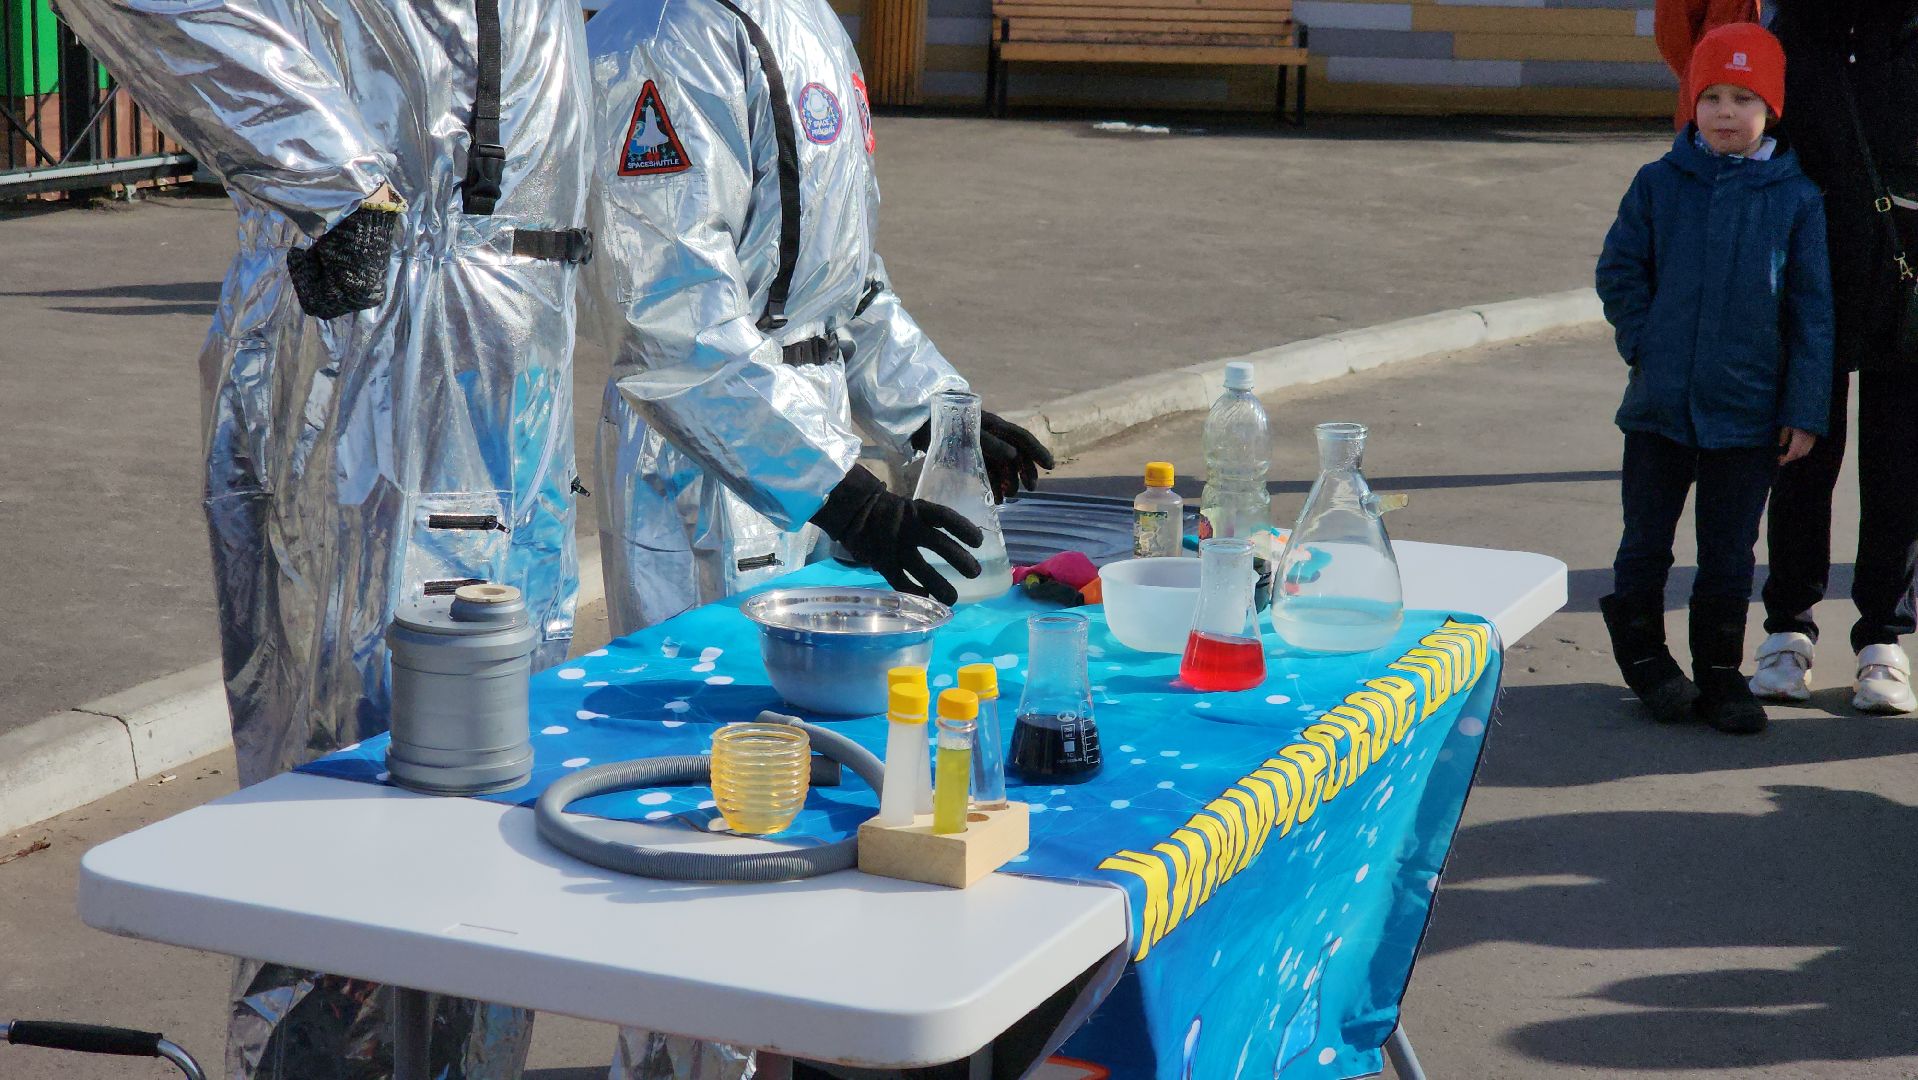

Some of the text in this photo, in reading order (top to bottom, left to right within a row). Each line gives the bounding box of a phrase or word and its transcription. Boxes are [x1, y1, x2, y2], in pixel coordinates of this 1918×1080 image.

[627, 158, 680, 169] SPACESHUTTLE
[1097, 616, 1490, 962] ХИМИЧЕСКОЕ ШОУ
